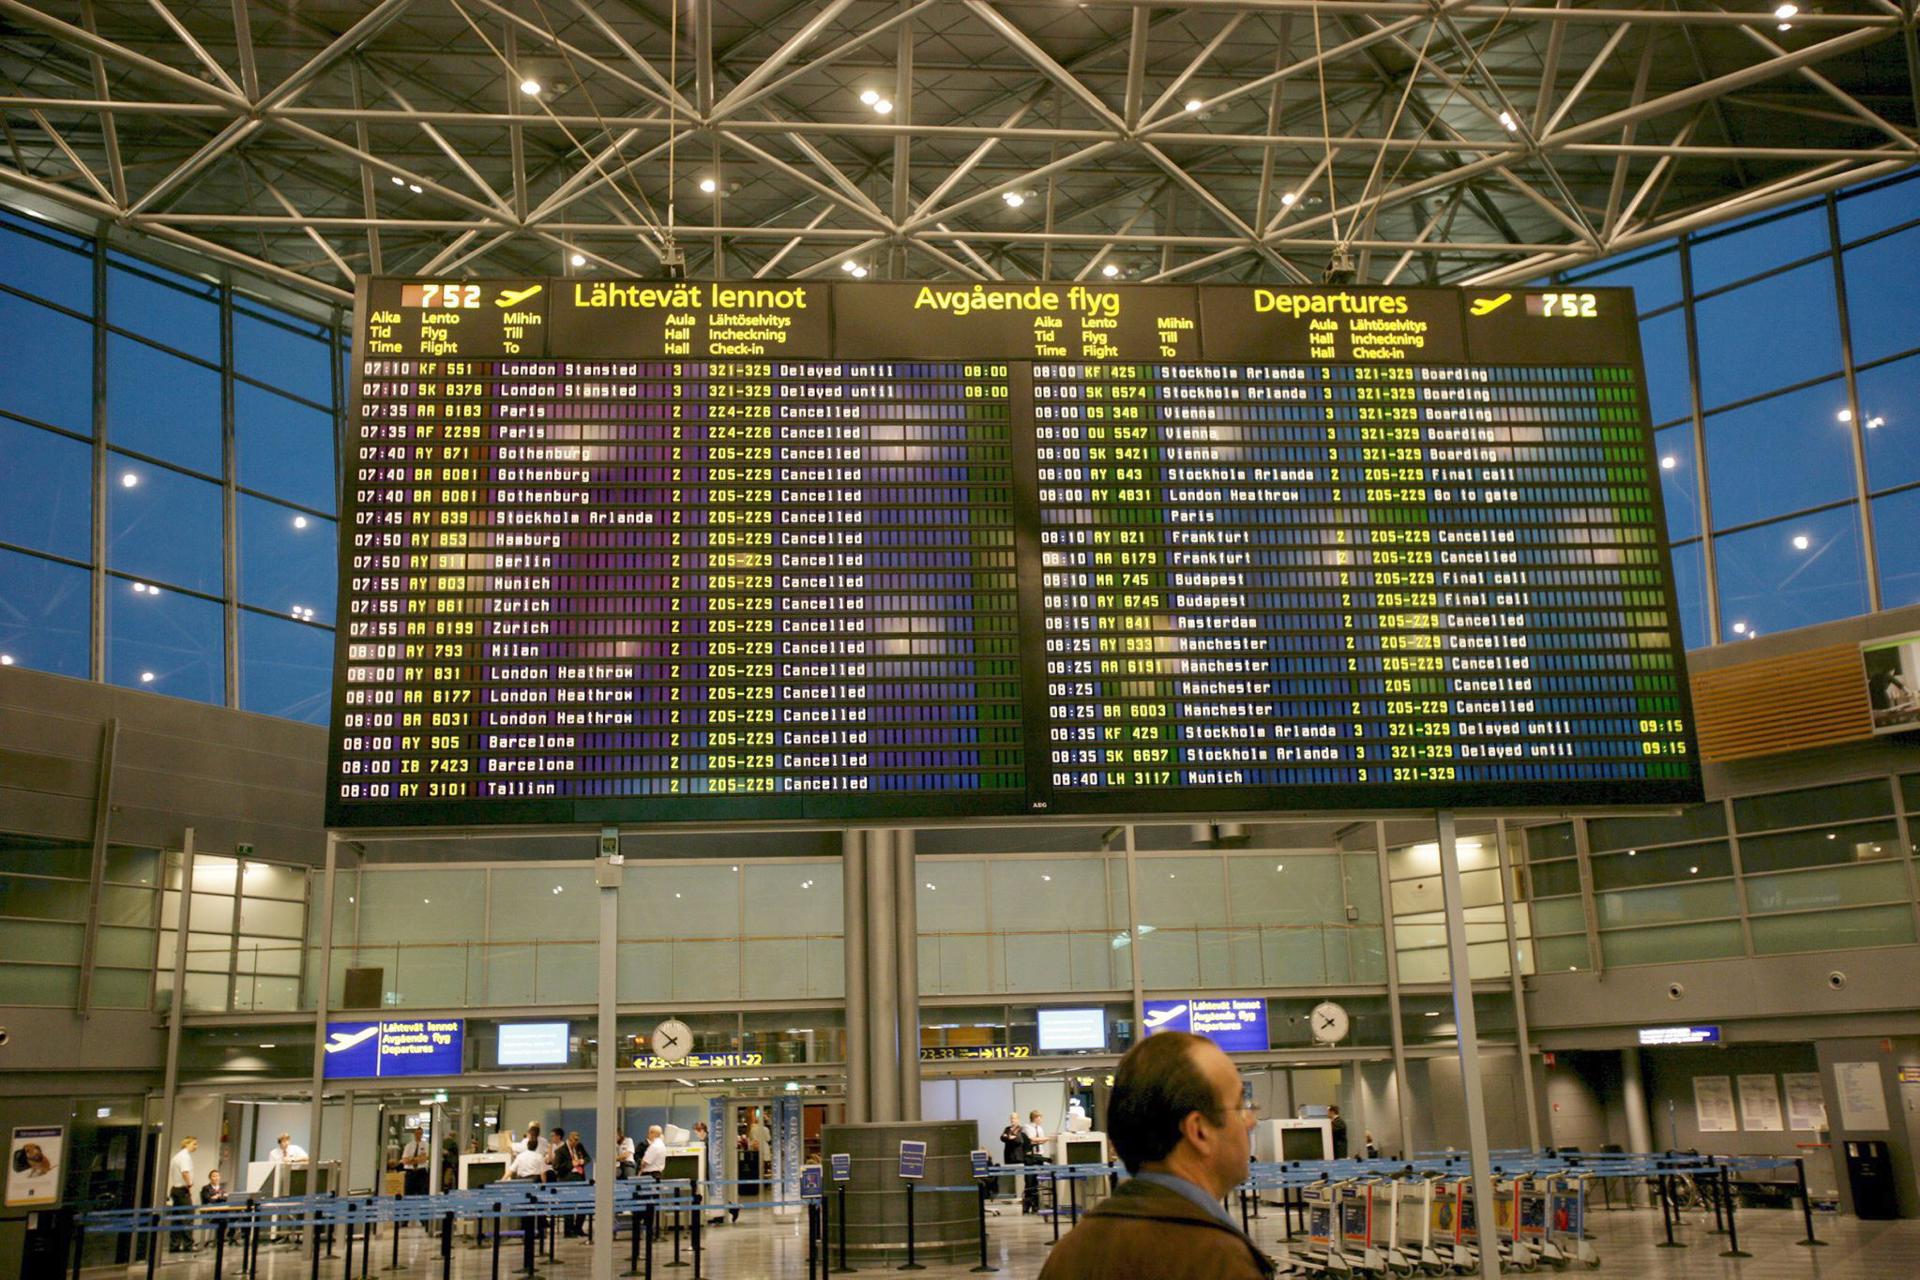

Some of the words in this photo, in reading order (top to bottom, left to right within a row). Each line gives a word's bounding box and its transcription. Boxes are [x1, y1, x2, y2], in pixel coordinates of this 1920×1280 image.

[422, 284, 481, 308] 752
[575, 283, 702, 308] Lähtevät
[712, 283, 807, 308] lennot
[914, 285, 1059, 315] Avgående
[1067, 287, 1120, 316] flyg
[1254, 289, 1408, 318] Departures
[1541, 293, 1597, 318] 752
[370, 311, 401, 323] Aika
[421, 312, 460, 324] Lento
[503, 313, 541, 325] Mihin
[665, 314, 696, 326] Aula
[709, 314, 791, 328] Lähtöselvitys
[1034, 316, 1062, 328] Aika
[1081, 317, 1117, 329] Lento
[1158, 317, 1193, 329] Mihin
[370, 326, 391, 338] Tid
[421, 326, 448, 340] Flyg
[504, 327, 523, 339] Till
[1309, 319, 1338, 331] Aula
[1350, 319, 1427, 334] Lähtöselvitys
[665, 329, 690, 340] Hall
[709, 329, 786, 342] Incheckning
[1035, 330, 1054, 342] Tid
[1082, 331, 1108, 344] Flyg
[1159, 331, 1177, 343] Till
[1310, 333, 1334, 345] Hall
[1351, 333, 1424, 348] Incheckning
[369, 341, 402, 353] Time
[421, 341, 458, 355] Flight
[503, 342, 520, 354] To
[665, 343, 690, 354] Hall
[709, 343, 764, 355] Check-in
[1035, 345, 1067, 356] Time
[1083, 345, 1119, 359] Flight
[1159, 345, 1176, 358] To
[1311, 347, 1335, 359] Hall
[1353, 347, 1405, 359] Check-in
[364, 363, 409, 375] 07:10
[419, 363, 437, 375] KF
[446, 363, 473, 375] 551
[501, 363, 555, 375] London
[565, 364, 636, 376] Stansted
[673, 364, 681, 376] 3
[709, 364, 770, 376] 321-329
[780, 365, 841, 379] Delayed
[851, 365, 894, 377] until
[964, 366, 1007, 377] 08:00
[1033, 366, 1075, 378] 08:00
[1084, 366, 1101, 378] KF
[1110, 366, 1135, 378] 425
[1161, 367, 1237, 378] Stockholm
[1246, 367, 1304, 379] Arlanda
[1321, 367, 1330, 379] 3
[1355, 367, 1413, 379] 321-329
[1421, 368, 1488, 382] Boarding
[1039, 489, 1082, 501] 08:00
[1091, 489, 1108, 501] AY
[1117, 489, 1152, 501] 4831
[1169, 489, 1221, 501] London
[1230, 489, 1298, 501] Heathrow
[1332, 489, 1341, 501] 2
[1366, 489, 1426, 501] 205-229
[1434, 489, 1451, 501] Go
[1459, 489, 1476, 501] to
[1484, 489, 1519, 503] gate
[355, 512, 402, 524] 07:45
[412, 512, 430, 524] AY
[496, 511, 579, 524] Stockholm
[589, 511, 653, 523] Arlanda
[672, 511, 680, 523] 2
[709, 511, 771, 523] 205-229
[782, 511, 862, 523] Cancelled
[1171, 510, 1214, 522] Paris
[353, 555, 400, 568] 07:50
[410, 555, 428, 568] AY
[438, 555, 466, 568] 911
[495, 555, 550, 567] Berlin
[672, 554, 680, 567] 2
[709, 554, 772, 566] 205-229
[782, 553, 863, 566] Cancelled
[1043, 574, 1087, 586] 08:10
[1122, 573, 1148, 586] 745
[1175, 573, 1245, 588] Budapest
[1340, 572, 1349, 585] 2
[1374, 572, 1434, 584] 205-229
[1443, 572, 1486, 584] Final
[1494, 571, 1528, 584] call
[348, 645, 395, 658] 08:00
[406, 645, 424, 657] AY
[435, 644, 462, 657] 793
[492, 644, 538, 657] Milan
[671, 642, 679, 655] 2
[709, 642, 773, 655] 205-229
[783, 641, 865, 654] Cancelled
[1046, 638, 1090, 651] 08:25
[1100, 638, 1117, 651] AY
[1126, 638, 1152, 651] 933
[1179, 637, 1267, 650] Manchester
[1346, 636, 1354, 649] 2
[1381, 636, 1441, 648] 205-229
[1450, 635, 1527, 648] Cancelled
[1050, 727, 1095, 740] 08:35
[1104, 726, 1122, 739] KF
[1131, 726, 1158, 739] 429
[1185, 725, 1265, 738] Stockholm
[1274, 724, 1336, 737] Arlanda
[1354, 723, 1363, 736] 3
[1389, 722, 1450, 736] 321-329
[1459, 721, 1520, 737] Delayed
[1528, 721, 1572, 734] until
[1640, 719, 1683, 733] 09:15
[342, 760, 390, 774] 08:00
[400, 760, 419, 773] IB
[430, 759, 468, 773] 7423
[488, 757, 574, 772] Barcelona
[671, 756, 679, 769] 2
[709, 755, 773, 769] 205-229
[784, 753, 867, 767] Cancelled
[1052, 772, 1097, 785] 08:40
[1107, 771, 1125, 785] LH
[1134, 771, 1170, 784] 3117
[1188, 770, 1242, 783] Munich
[1358, 768, 1367, 781] 3
[1393, 767, 1455, 780] 321-329
[340, 784, 389, 798] 08:00
[399, 783, 418, 797] AY
[429, 782, 467, 796] 3101
[487, 781, 554, 795] Tallinn
[670, 779, 679, 792] 2
[709, 778, 774, 792] 205-229
[784, 776, 868, 791] Cancelled
[427, 1022, 458, 1031] lennot
[432, 1032, 451, 1044] flyg
[382, 1045, 433, 1056] Departures
[995, 1046, 1030, 1058] 11-22
[727, 1054, 762, 1066] 11-22
